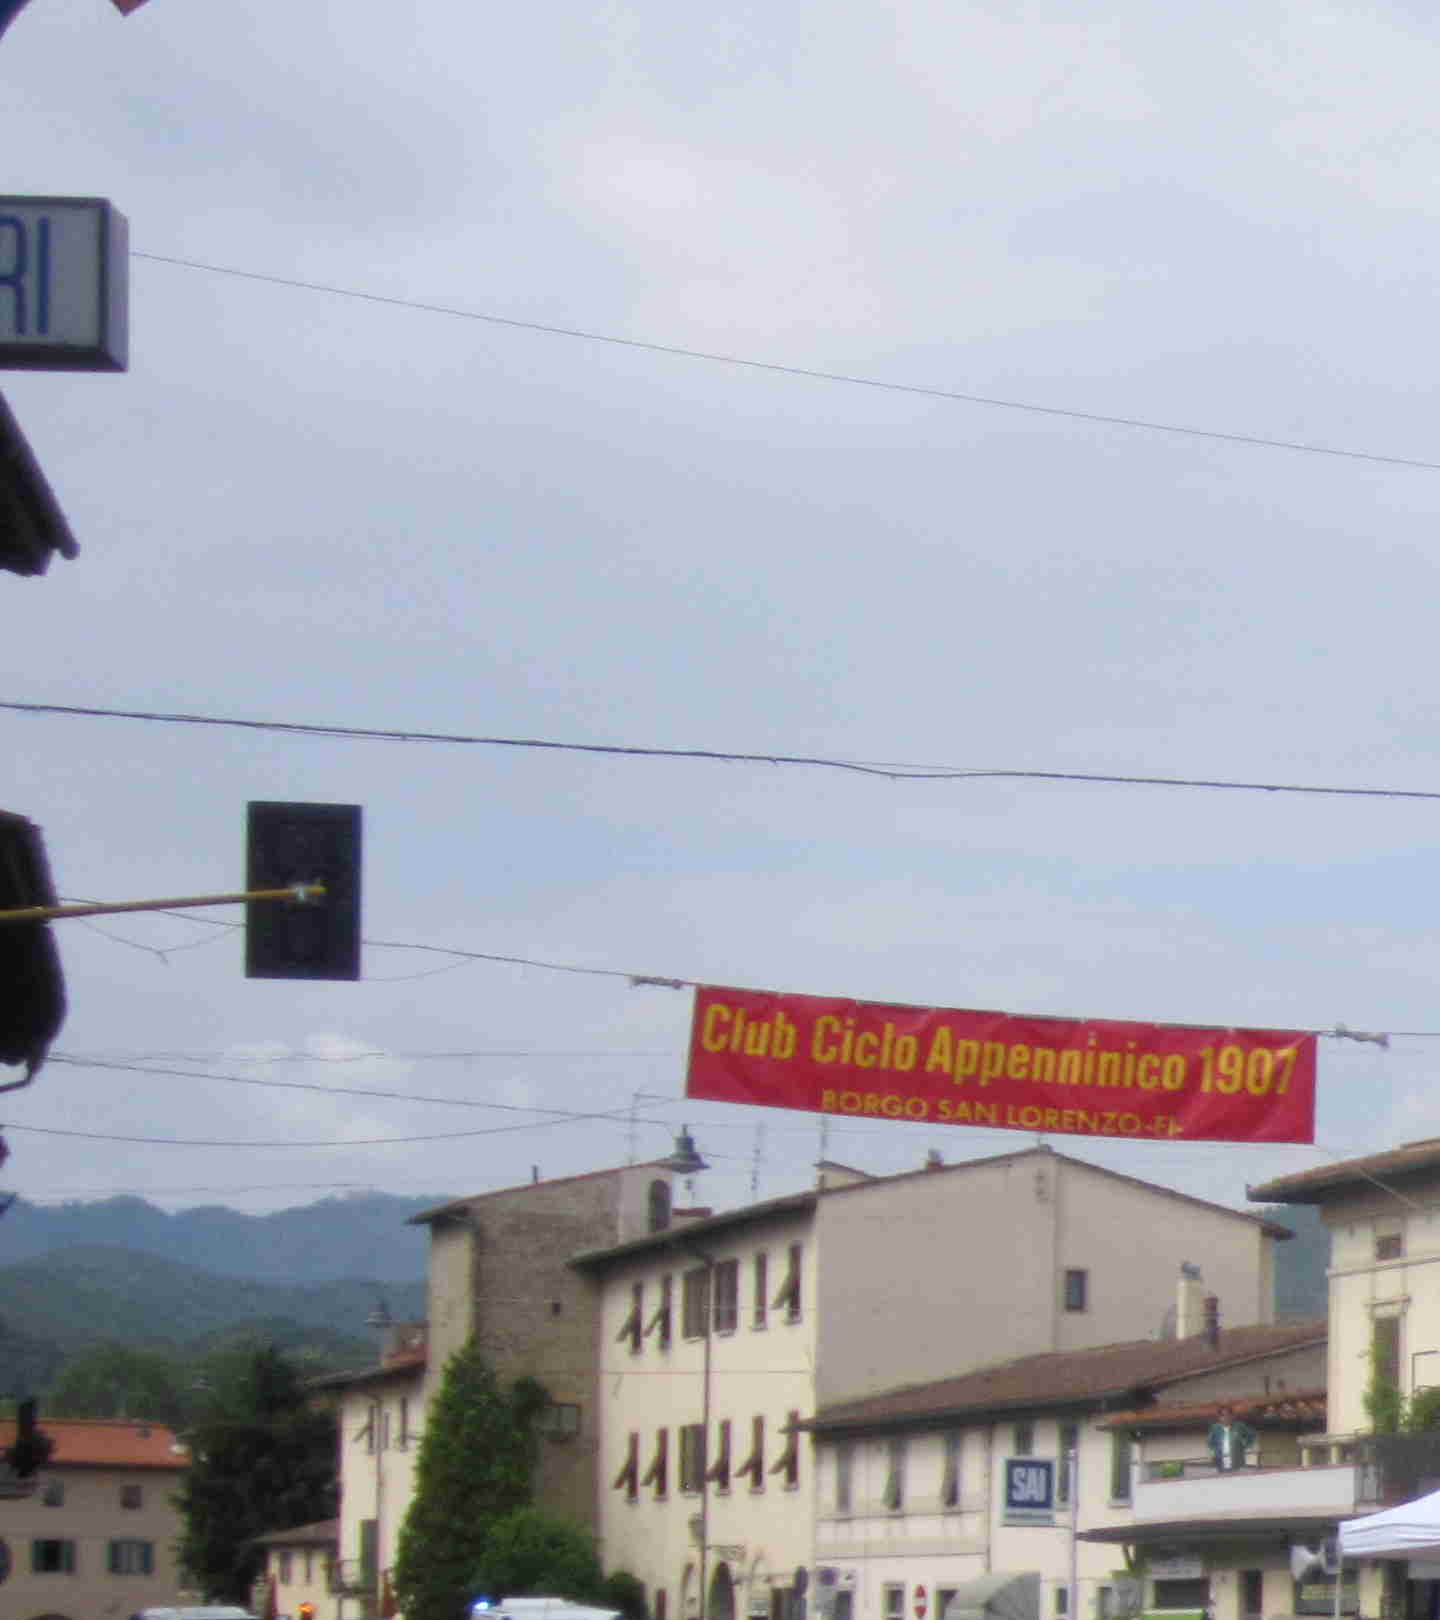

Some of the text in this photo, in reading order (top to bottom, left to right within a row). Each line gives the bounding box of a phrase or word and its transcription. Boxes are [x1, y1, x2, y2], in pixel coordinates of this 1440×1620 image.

[702, 1003, 1299, 1097] Club Ciclo Appenninico 1907
[821, 1088, 929, 1118] BORGO
[938, 1098, 999, 1125] SAN
[1012, 1467, 1047, 1501] SAI
